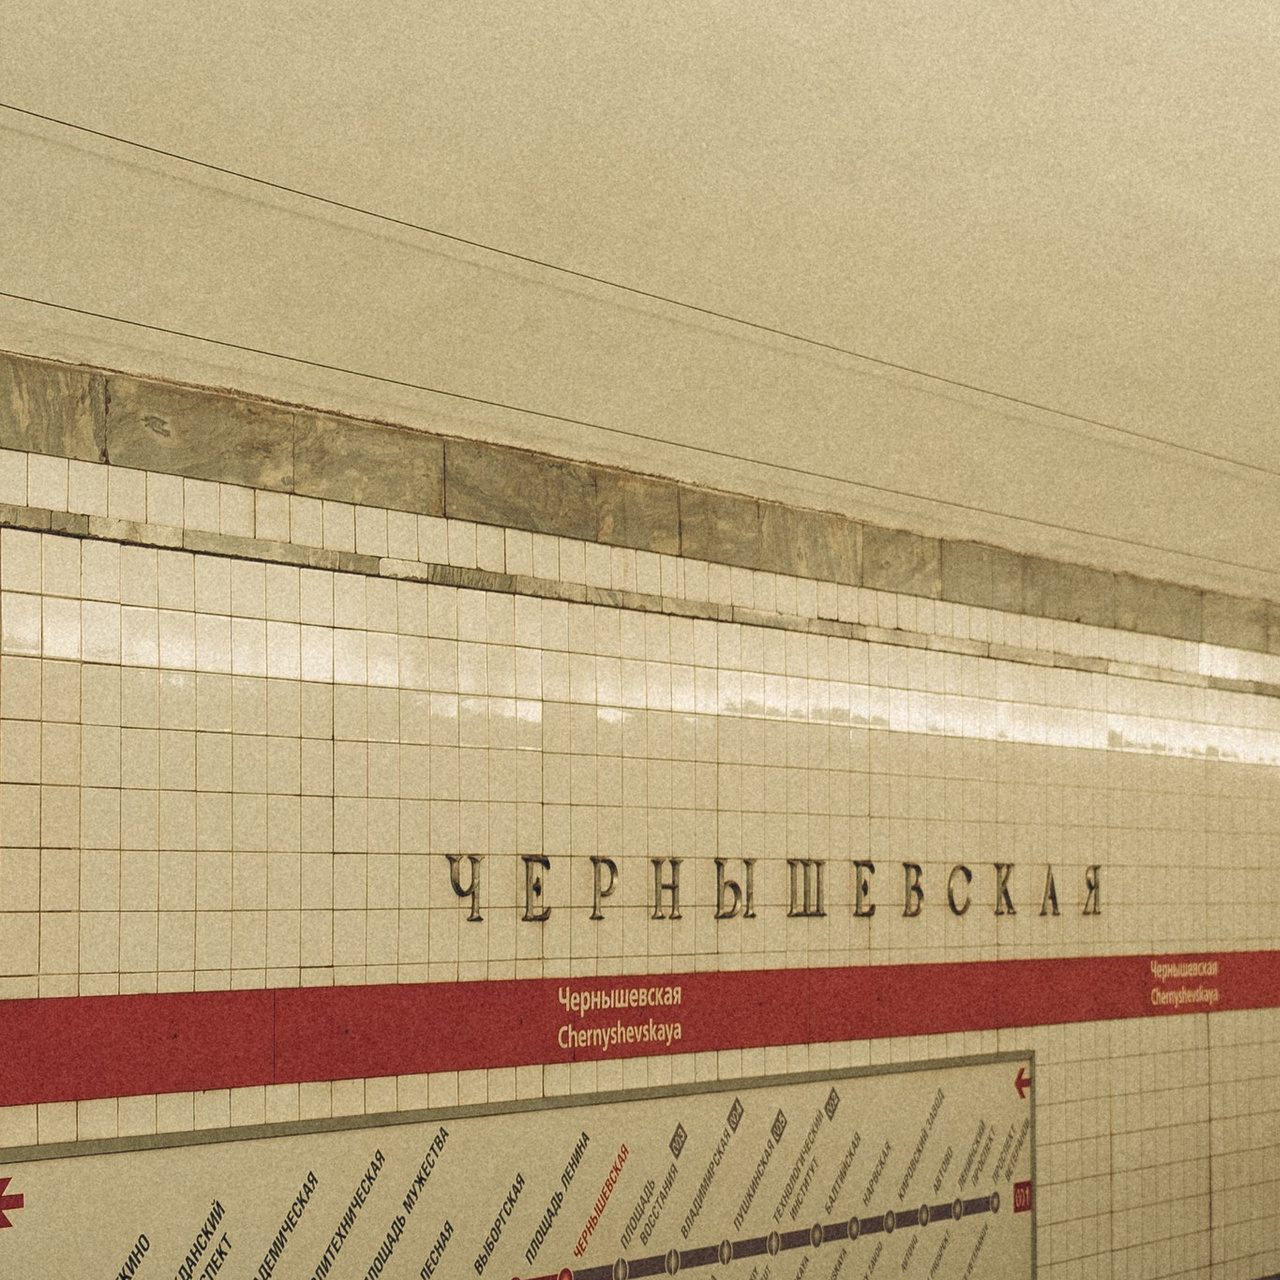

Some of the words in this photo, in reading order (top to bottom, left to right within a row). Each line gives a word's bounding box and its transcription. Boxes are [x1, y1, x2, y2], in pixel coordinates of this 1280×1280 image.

[445, 853, 1102, 922] ЧЕРНЫШЕВСКАЯ
[558, 986, 682, 1018] Чернышевская
[1150, 960, 1219, 983] Чернышевская
[1150, 985, 1219, 1009] Chernyshevskaya
[558, 1018, 682, 1051] Chernyshevskaya
[928, 1088, 946, 1130] ЗАВОД
[402, 1126, 450, 1214] МУЖЕСТВА
[524, 1191, 564, 1265] ПЛОЩАДЬ
[560, 1131, 590, 1192] ЛЕНИНА
[573, 1143, 630, 1258] ЧЕРНЫШЕВСКАЯ
[639, 1163, 679, 1247] ВОССТАНИЯ
[680, 1128, 731, 1240] ВЛАДИМИРСКАЯ
[733, 1139, 775, 1232] ПУШКИНСКАЯ
[772, 1109, 824, 1224] ТЕХНОЛОГИЧЕСКИЙ
[789, 1156, 820, 1220] ИНСТИТУТ
[824, 1131, 862, 1215] БАЛТИЙСКАЯ
[862, 1140, 892, 1207] НАРВСКАЯ
[473, 1172, 526, 1276] ВЫБОРГСКАЯ
[620, 1179, 656, 1250] ПЛОЩАДЬ
